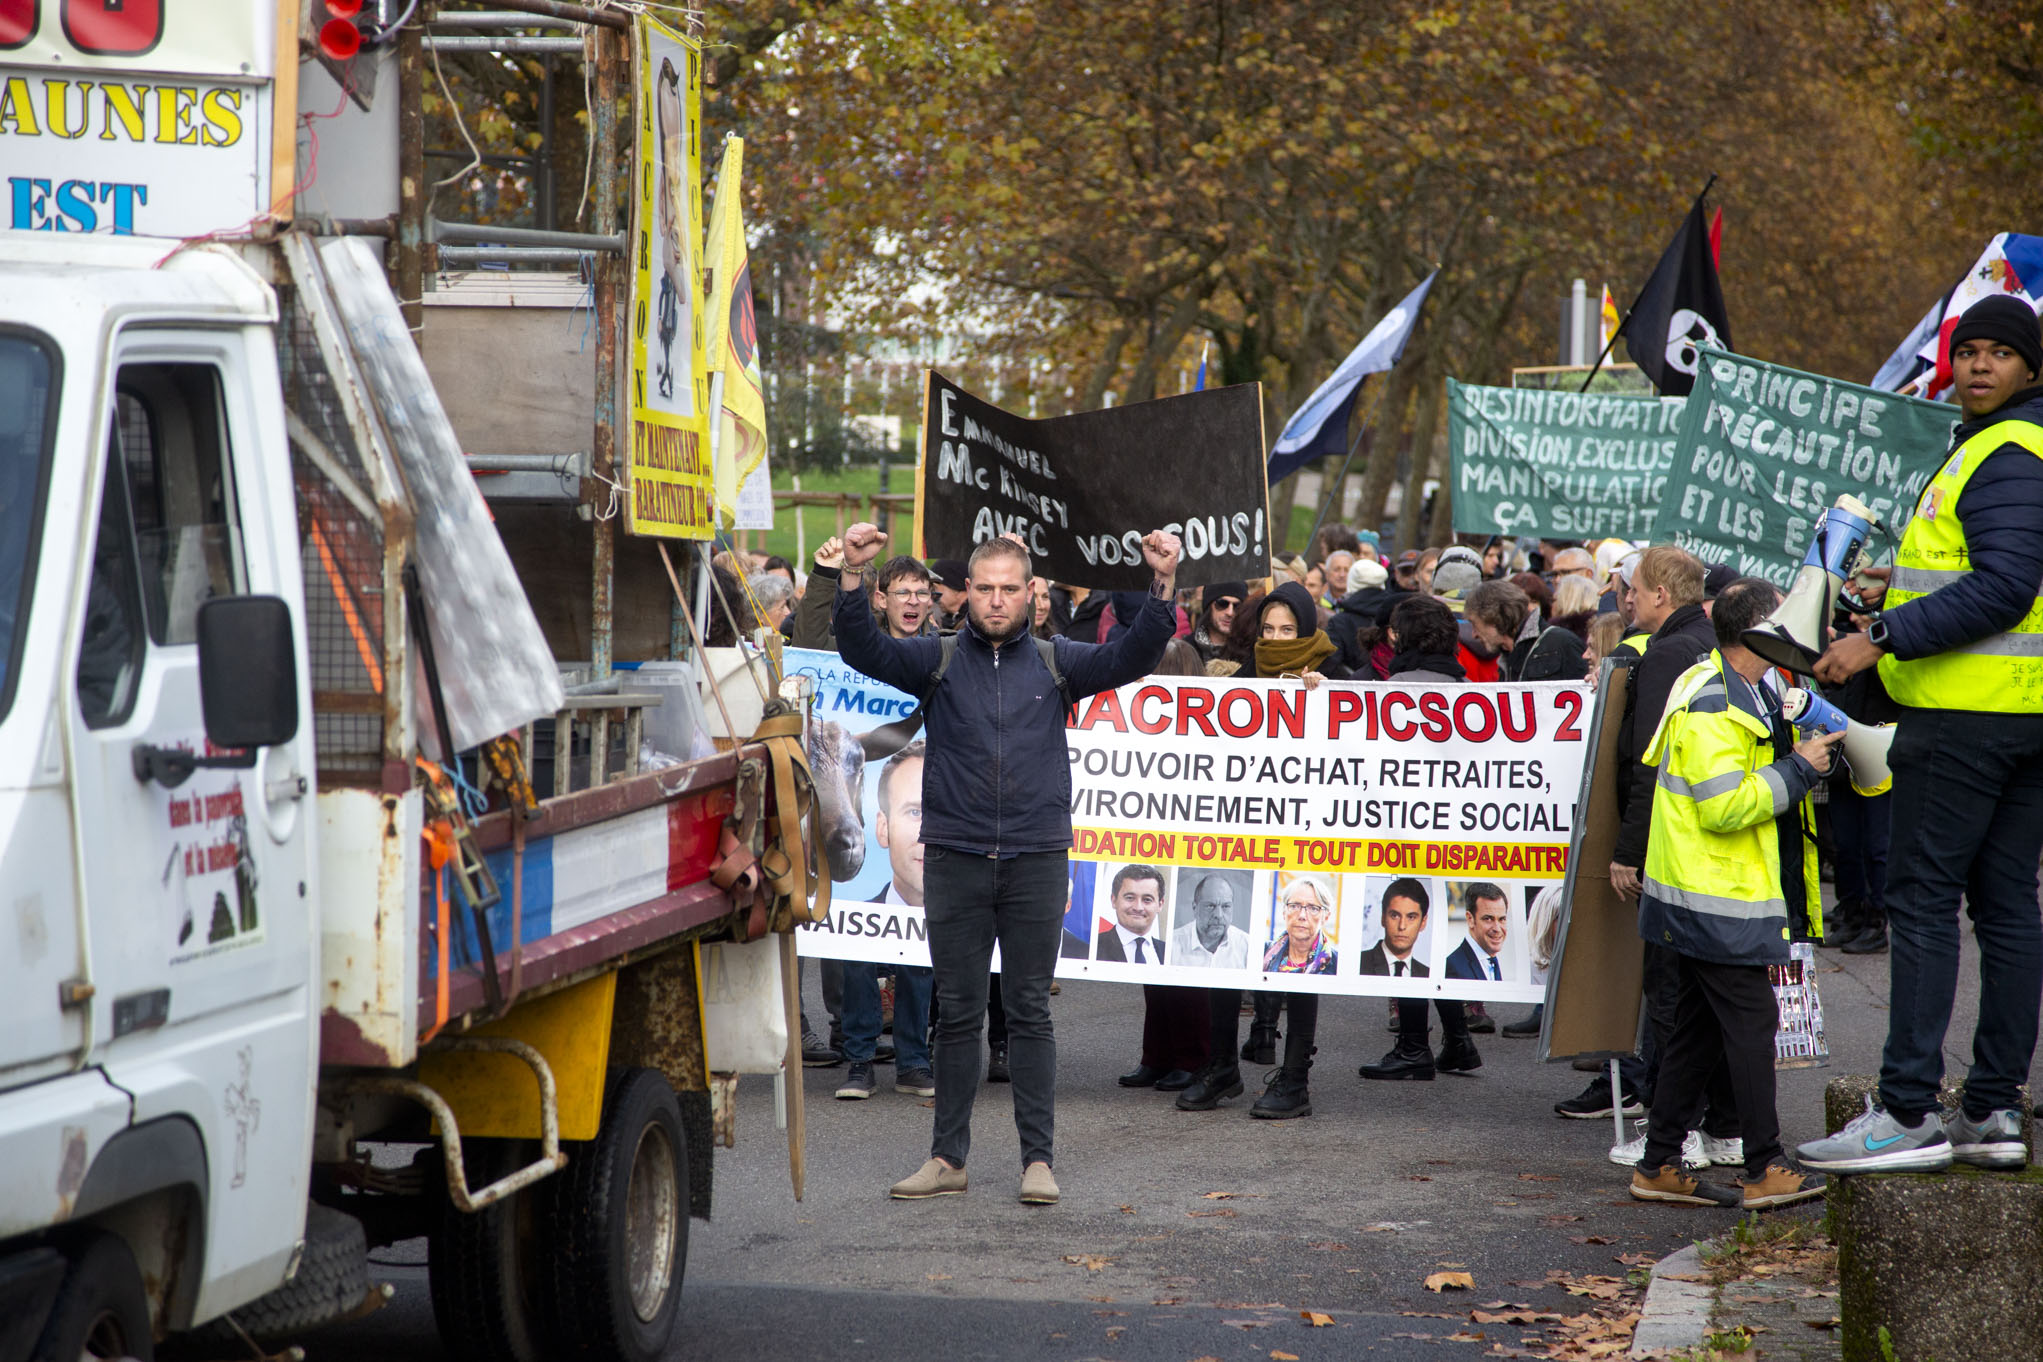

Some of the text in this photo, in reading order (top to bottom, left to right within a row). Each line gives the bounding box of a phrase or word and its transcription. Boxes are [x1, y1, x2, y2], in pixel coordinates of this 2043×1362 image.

[0, 77, 243, 147] AUNES
[8, 177, 147, 236] EST
[634, 420, 645, 467] ET
[647, 422, 700, 475] MAINTENANT
[635, 477, 695, 527] BARATINEUR
[1691, 444, 1756, 495] POUR
[1773, 470, 1827, 514] LES
[972, 506, 1048, 557] AVEC
[1076, 530, 1142, 566] VOS
[1494, 501, 1538, 535] ÇA
[1680, 484, 1764, 542] ET LES
[818, 668, 835, 681] LA
[832, 688, 919, 718] Marc
[1065, 684, 1583, 743] ACRON PICSOU 2
[1068, 747, 1551, 793] POUVOIR D'ACHAT, RETRAITES,
[1322, 799, 1450, 830] JUSTICE
[1460, 802, 1577, 832] SOCIAL
[1183, 835, 1285, 868] TOTALE,
[1294, 839, 1361, 867] TOUT
[1367, 842, 1420, 869] DOIT
